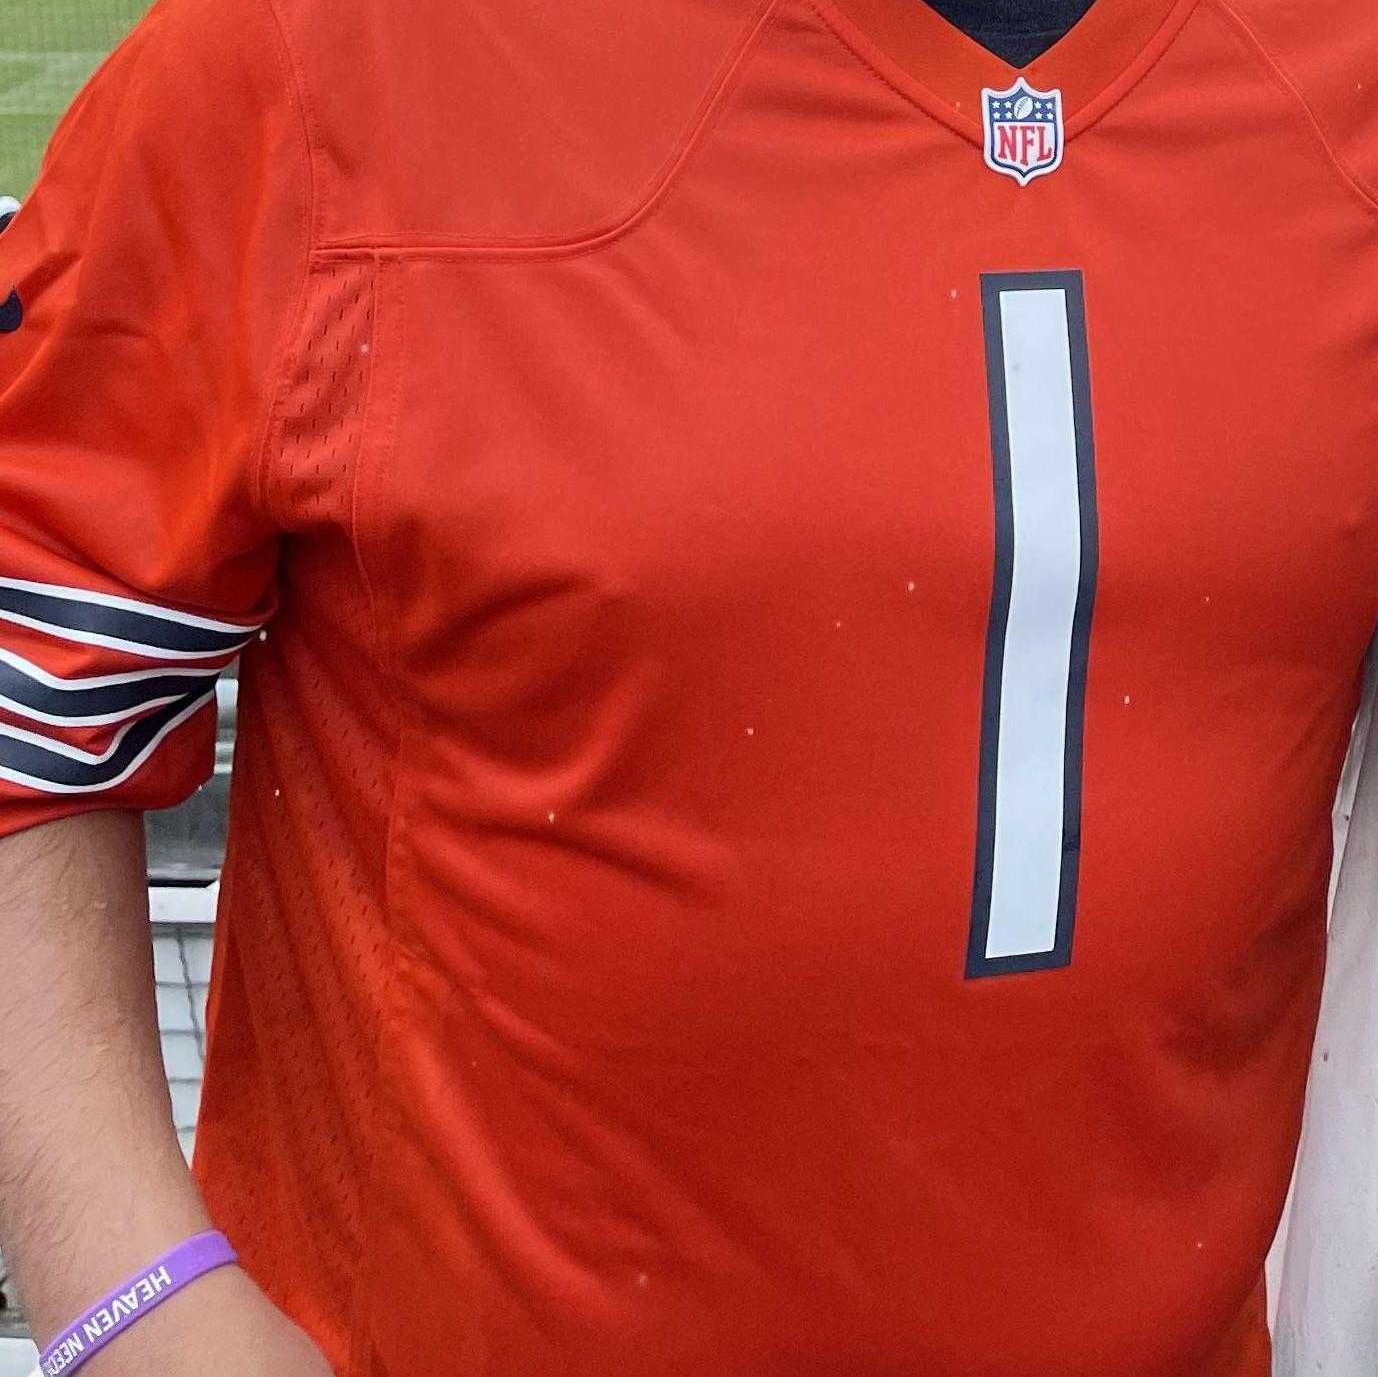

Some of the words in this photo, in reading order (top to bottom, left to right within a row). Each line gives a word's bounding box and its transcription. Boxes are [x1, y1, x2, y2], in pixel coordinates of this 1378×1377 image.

[997, 125, 1053, 167] NFL
[963, 269, 1100, 980] 1
[82, 1265, 172, 1342] HEAVEN
